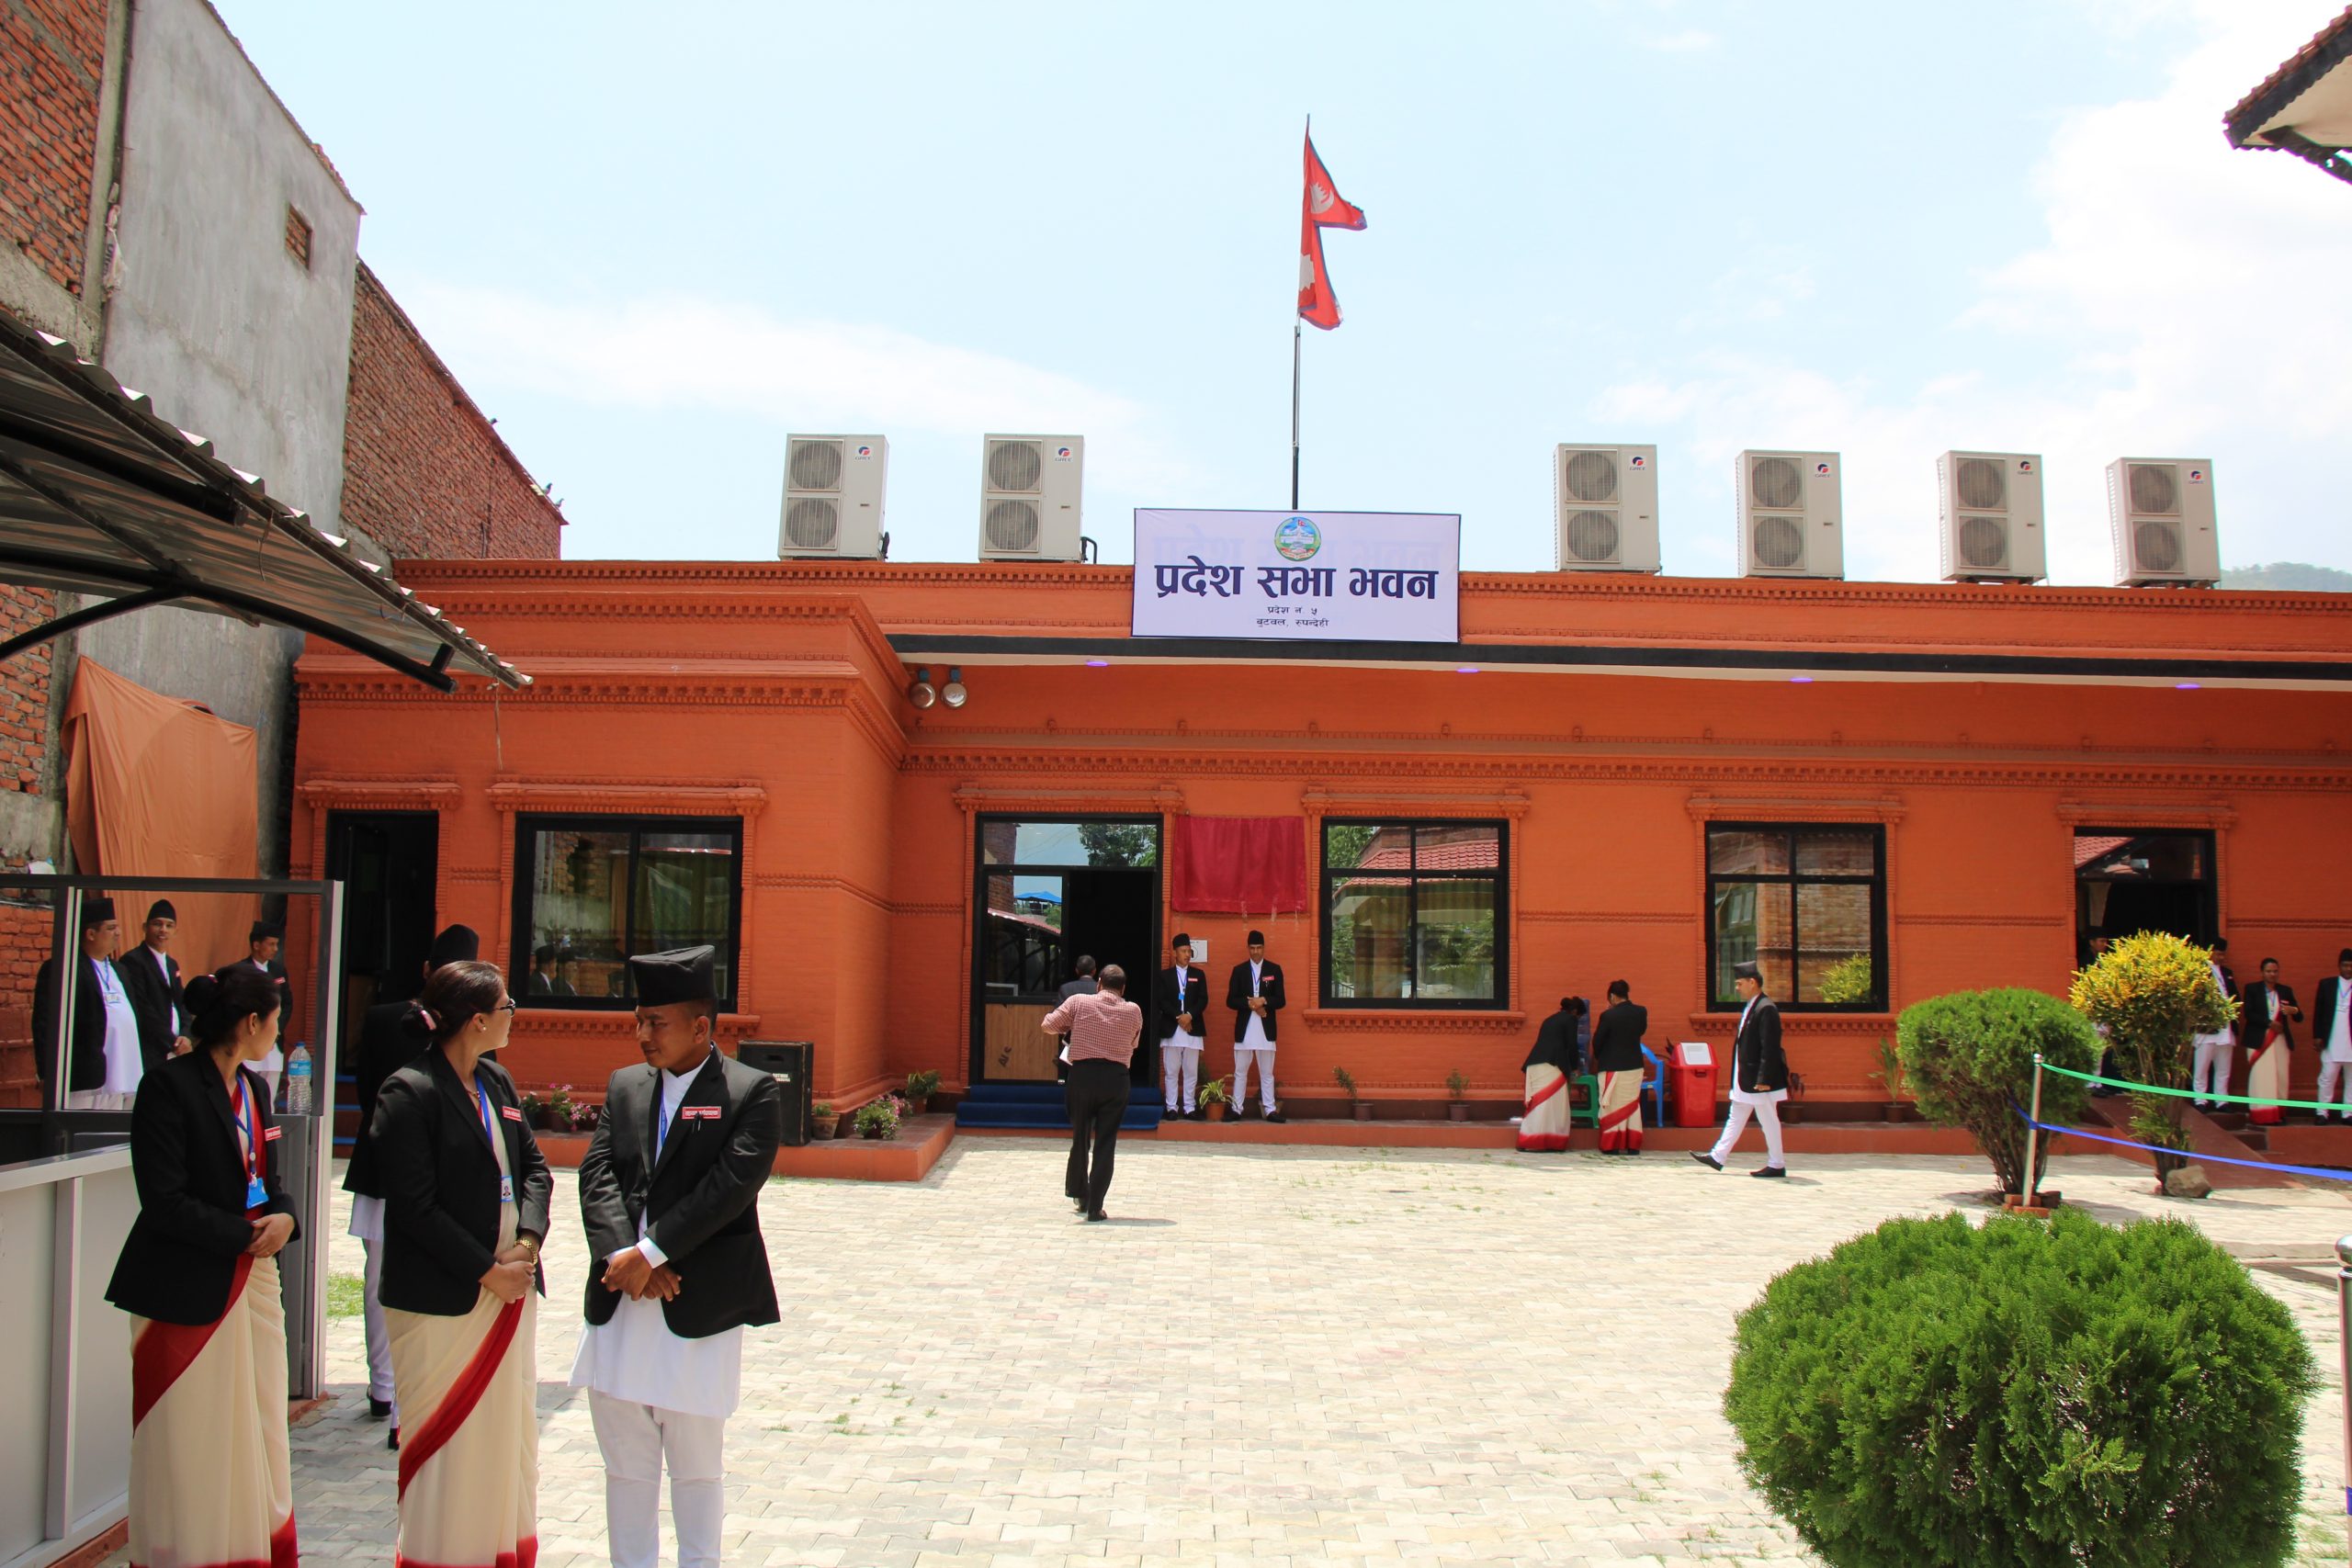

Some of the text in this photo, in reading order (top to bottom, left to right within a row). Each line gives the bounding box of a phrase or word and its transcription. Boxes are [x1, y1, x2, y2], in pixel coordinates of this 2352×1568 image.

[1154, 555, 1440, 600] प्रदेश सभा भवन
[1267, 605, 1290, 615] प्रदेश
